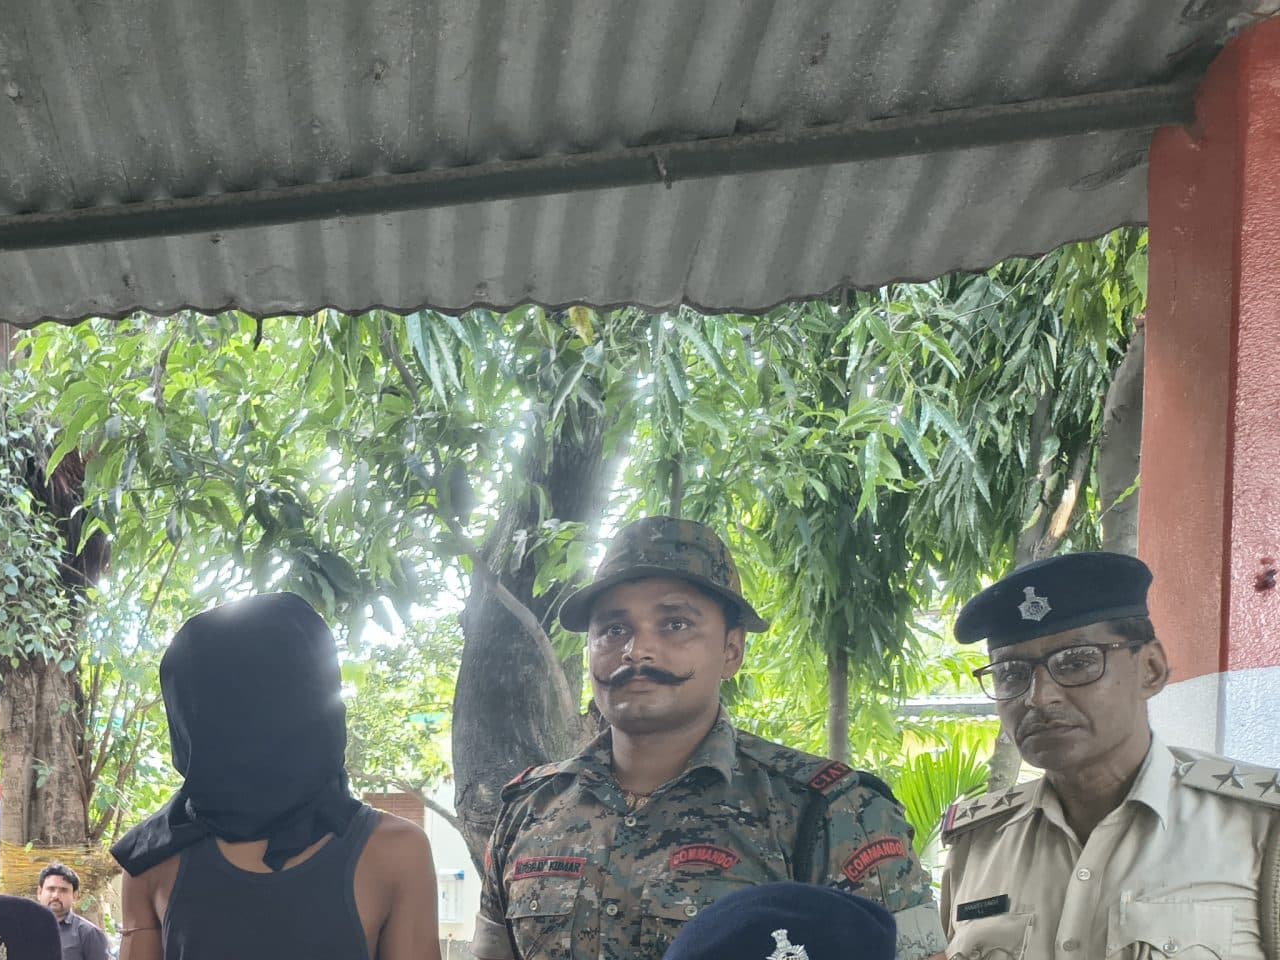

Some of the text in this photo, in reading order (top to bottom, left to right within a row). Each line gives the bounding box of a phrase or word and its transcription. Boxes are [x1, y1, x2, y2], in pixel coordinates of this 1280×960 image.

[549, 860, 581, 873] KUMAR
[673, 847, 733, 869] COMMANDO
[846, 841, 905, 877] COMMANDO
